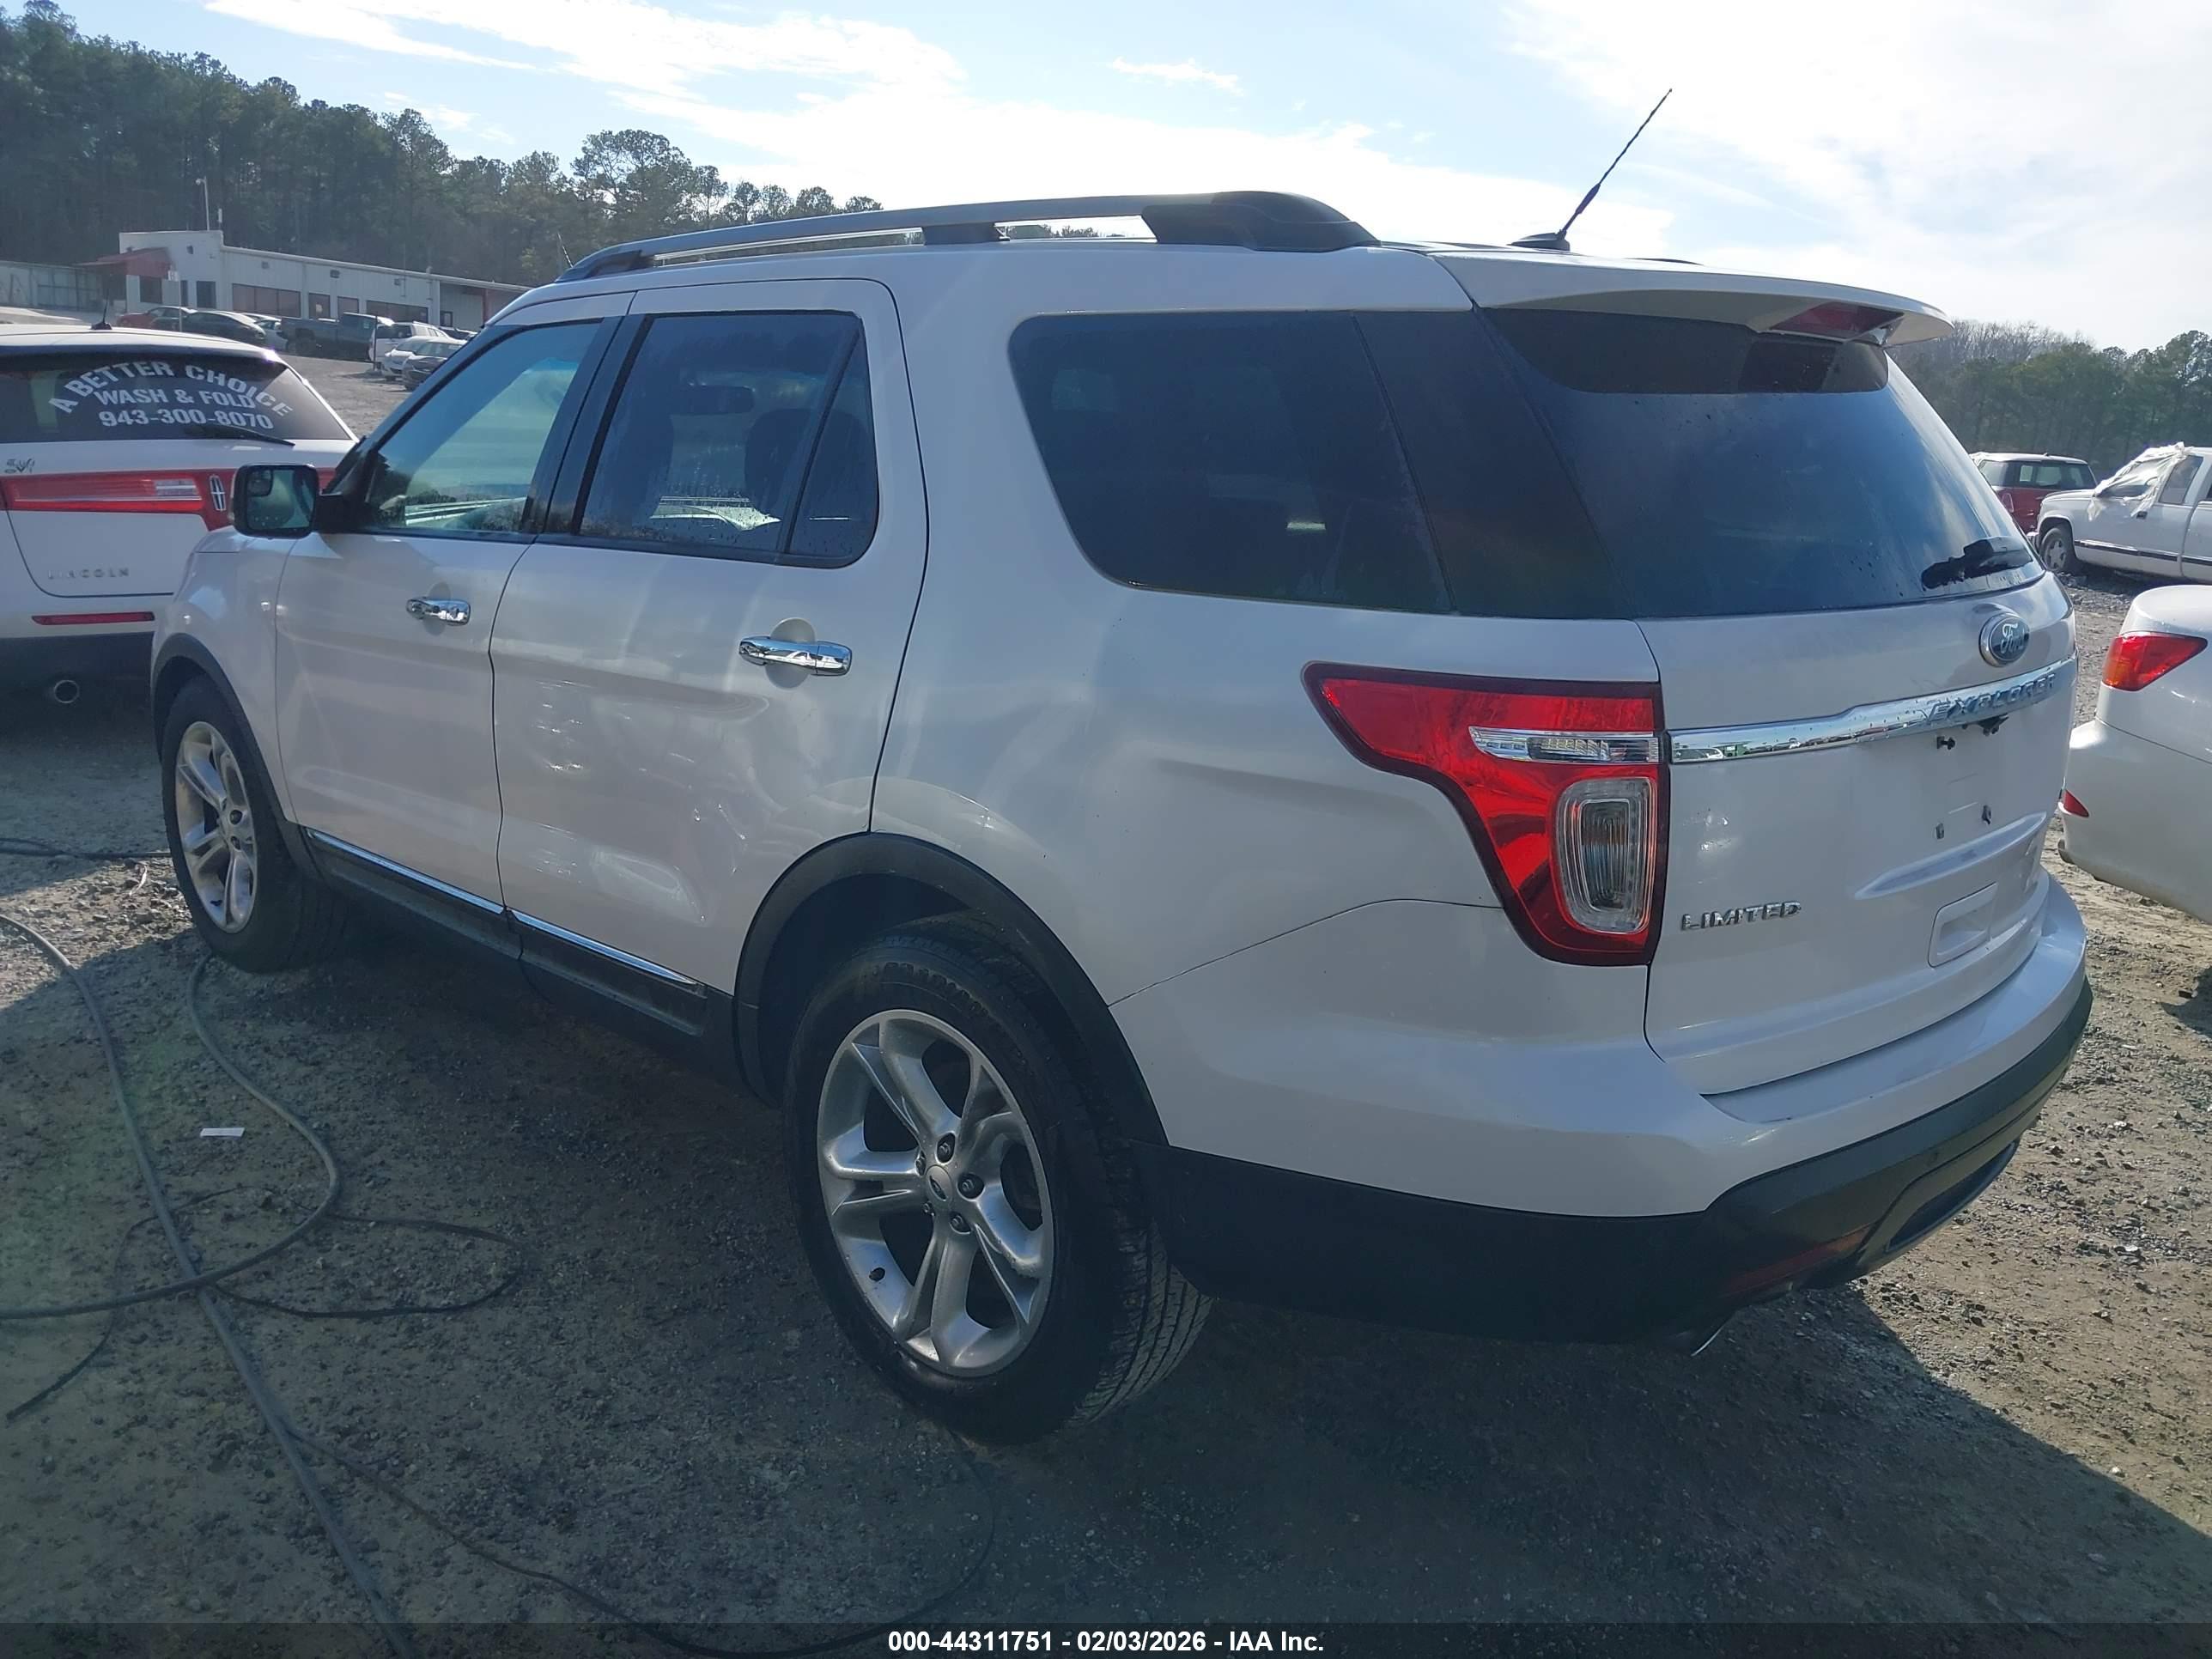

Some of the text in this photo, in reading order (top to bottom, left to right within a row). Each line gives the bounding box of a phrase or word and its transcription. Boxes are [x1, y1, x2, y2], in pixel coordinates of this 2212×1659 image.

[48, 361, 294, 418] A BETTER CHOICE
[93, 389, 256, 409] WASH & FOLD
[99, 408, 275, 430] 943-300-8070
[47, 567, 130, 580] LINCOLN
[1926, 672, 2056, 724] EXPLORER
[1680, 899, 1802, 931] LIMITED
